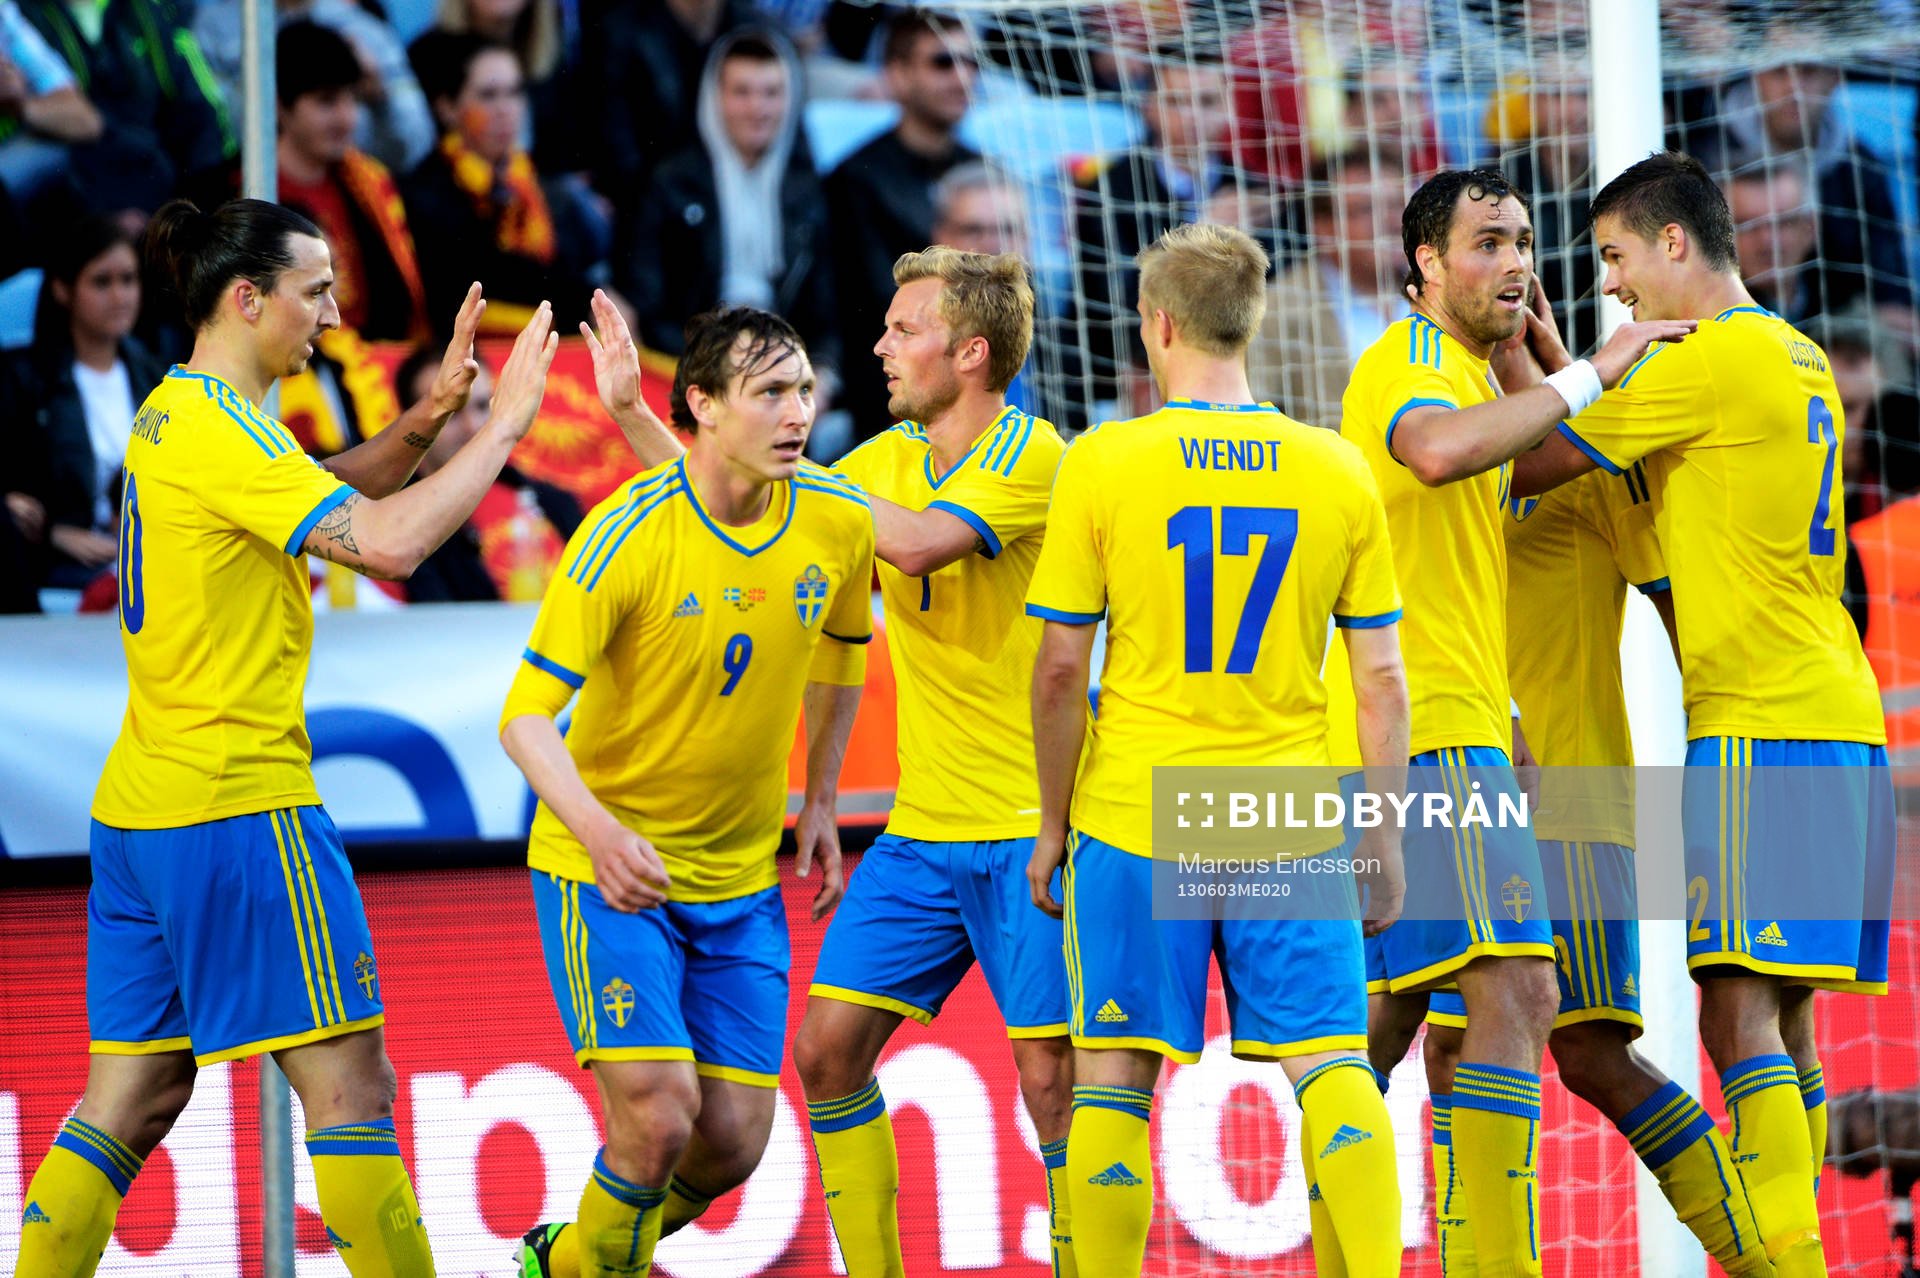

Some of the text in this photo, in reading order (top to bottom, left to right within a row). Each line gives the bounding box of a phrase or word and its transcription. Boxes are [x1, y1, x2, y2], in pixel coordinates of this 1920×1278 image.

[1179, 437, 1281, 472] WENDT
[1808, 395, 1838, 556] 2
[1167, 506, 1298, 674] 17
[719, 633, 753, 696] 9
[1687, 876, 1710, 942] 2
[1755, 936, 1788, 947] adidas
[1095, 1013, 1128, 1022] adidas
[1320, 1131, 1373, 1158] adidas
[1088, 1175, 1143, 1186] adidas
